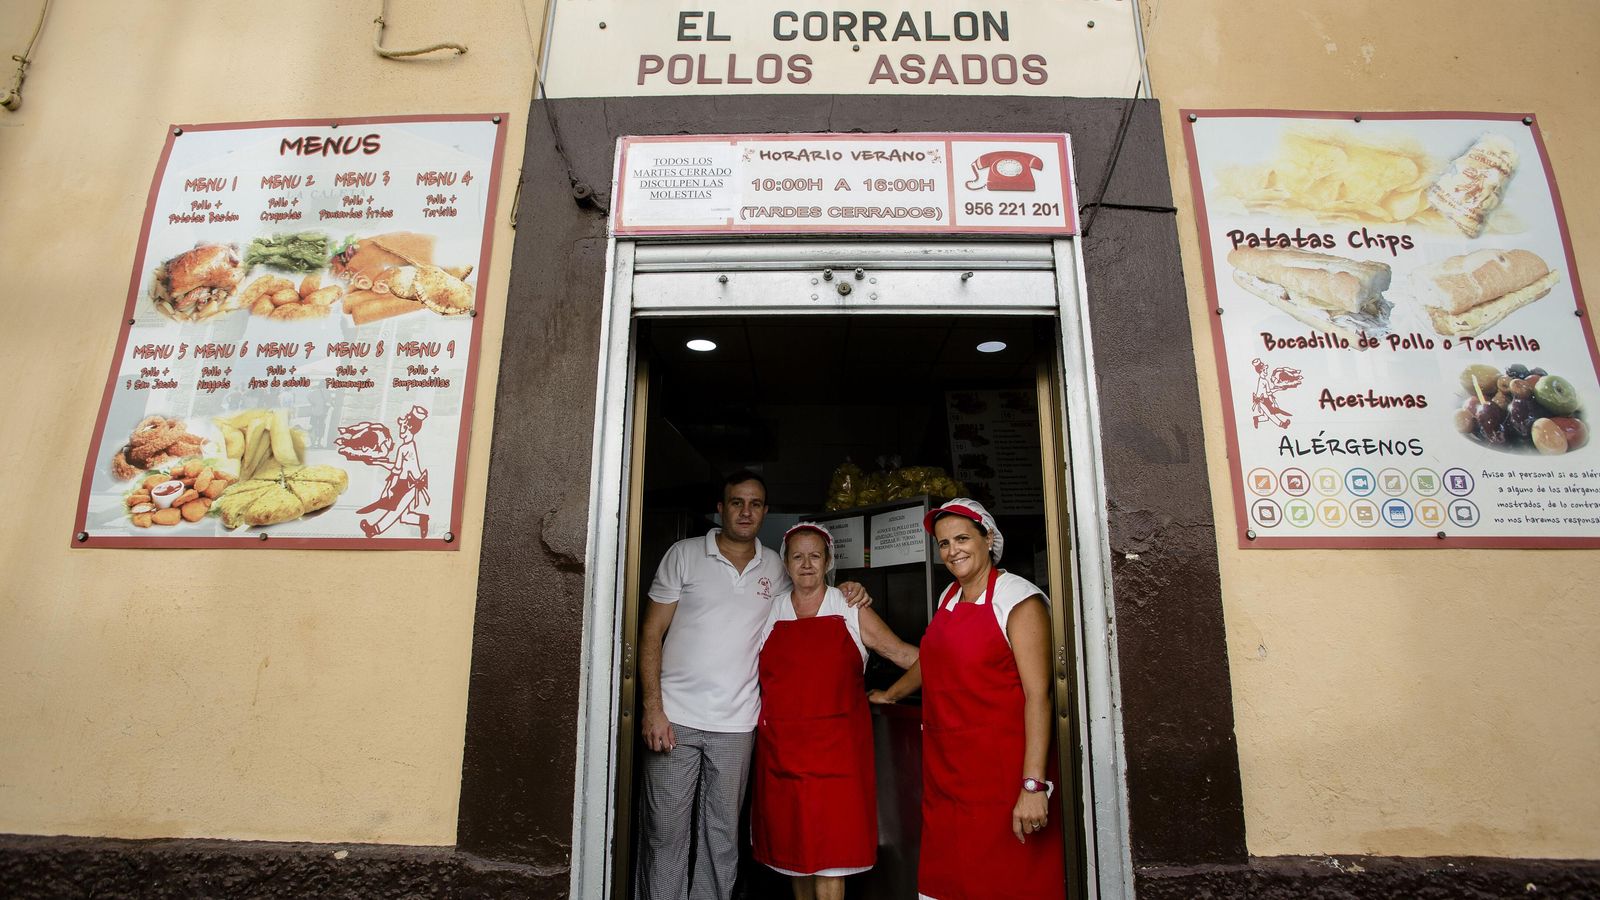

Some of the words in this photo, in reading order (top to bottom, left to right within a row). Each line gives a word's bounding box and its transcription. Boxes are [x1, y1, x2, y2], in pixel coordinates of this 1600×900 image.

[677, 10, 731, 41] EL
[772, 10, 1010, 41] CORRALON
[636, 53, 813, 85] POLLOS
[868, 53, 1049, 85] ASADOS
[279, 133, 381, 157] MENUS
[653, 157, 689, 166] TODOS
[692, 157, 713, 166] LOS
[759, 148, 843, 162] HORARIO
[851, 148, 926, 162] VERANO
[334, 171, 377, 187] MENU
[382, 170, 391, 186] 3
[416, 171, 457, 187] MENU
[461, 170, 474, 186] 4
[633, 168, 678, 177] MARTES
[679, 167, 732, 177] CERRADO
[184, 176, 227, 193] MENU
[231, 175, 238, 191] 1
[260, 174, 301, 190] MENU
[305, 174, 316, 187] 2
[640, 179, 700, 189] DISCULPEN
[703, 179, 724, 188] LAS
[752, 178, 823, 192] 10:00H
[834, 178, 851, 192] A
[863, 178, 935, 192] 16:00H
[342, 195, 364, 207] Pollo
[366, 196, 374, 205] +
[426, 194, 446, 206] Pollo
[449, 194, 457, 204] +
[650, 190, 712, 200] MOLESTIAS
[190, 199, 211, 212] Pollo
[214, 200, 222, 209] +
[268, 197, 288, 209] Pollo
[291, 197, 299, 206] +
[964, 202, 994, 216] 956
[999, 202, 1026, 216] 221
[1032, 202, 1060, 216] 201
[739, 206, 822, 220] (TARDES
[827, 206, 943, 221] CERRADOS)
[1226, 227, 1336, 251] Patatas
[1347, 227, 1415, 257] Chips
[1260, 330, 1349, 352] Bocadillo
[1358, 330, 1381, 350] de
[1386, 333, 1434, 352] Pollo
[1443, 338, 1452, 351] o
[1459, 334, 1541, 352] Tortilla
[133, 343, 174, 360] MENU
[178, 342, 189, 360] 5
[194, 343, 236, 359] MENU
[239, 341, 249, 358] 6
[256, 342, 299, 359] MENU
[304, 341, 315, 359] 7
[326, 341, 371, 359] MENU
[375, 340, 384, 358] 8
[397, 340, 441, 359] MENU
[446, 340, 455, 359] 9
[140, 366, 161, 378] Pollo
[201, 366, 222, 378] Pollo
[266, 365, 287, 376] Pollo
[336, 364, 357, 377] Pollo
[360, 366, 368, 375] +
[407, 364, 428, 376] Pollo
[431, 365, 439, 375] +
[270, 376, 281, 387] de
[1318, 388, 1428, 411] Aceitunas
[1278, 430, 1424, 458] ALÉRGENOS
[1481, 469, 1504, 479] Avise
[1508, 470, 1516, 478] al
[1519, 470, 1555, 480] personal
[1581, 469, 1600, 478] alér
[1507, 486, 1533, 496] alguno
[1536, 485, 1545, 493] de
[1497, 500, 1545, 511] mostrados,
[1547, 500, 1557, 508] de
[1560, 500, 1567, 508] lo
[1525, 515, 1560, 524] haremos
[1563, 516, 1600, 526] responsa
